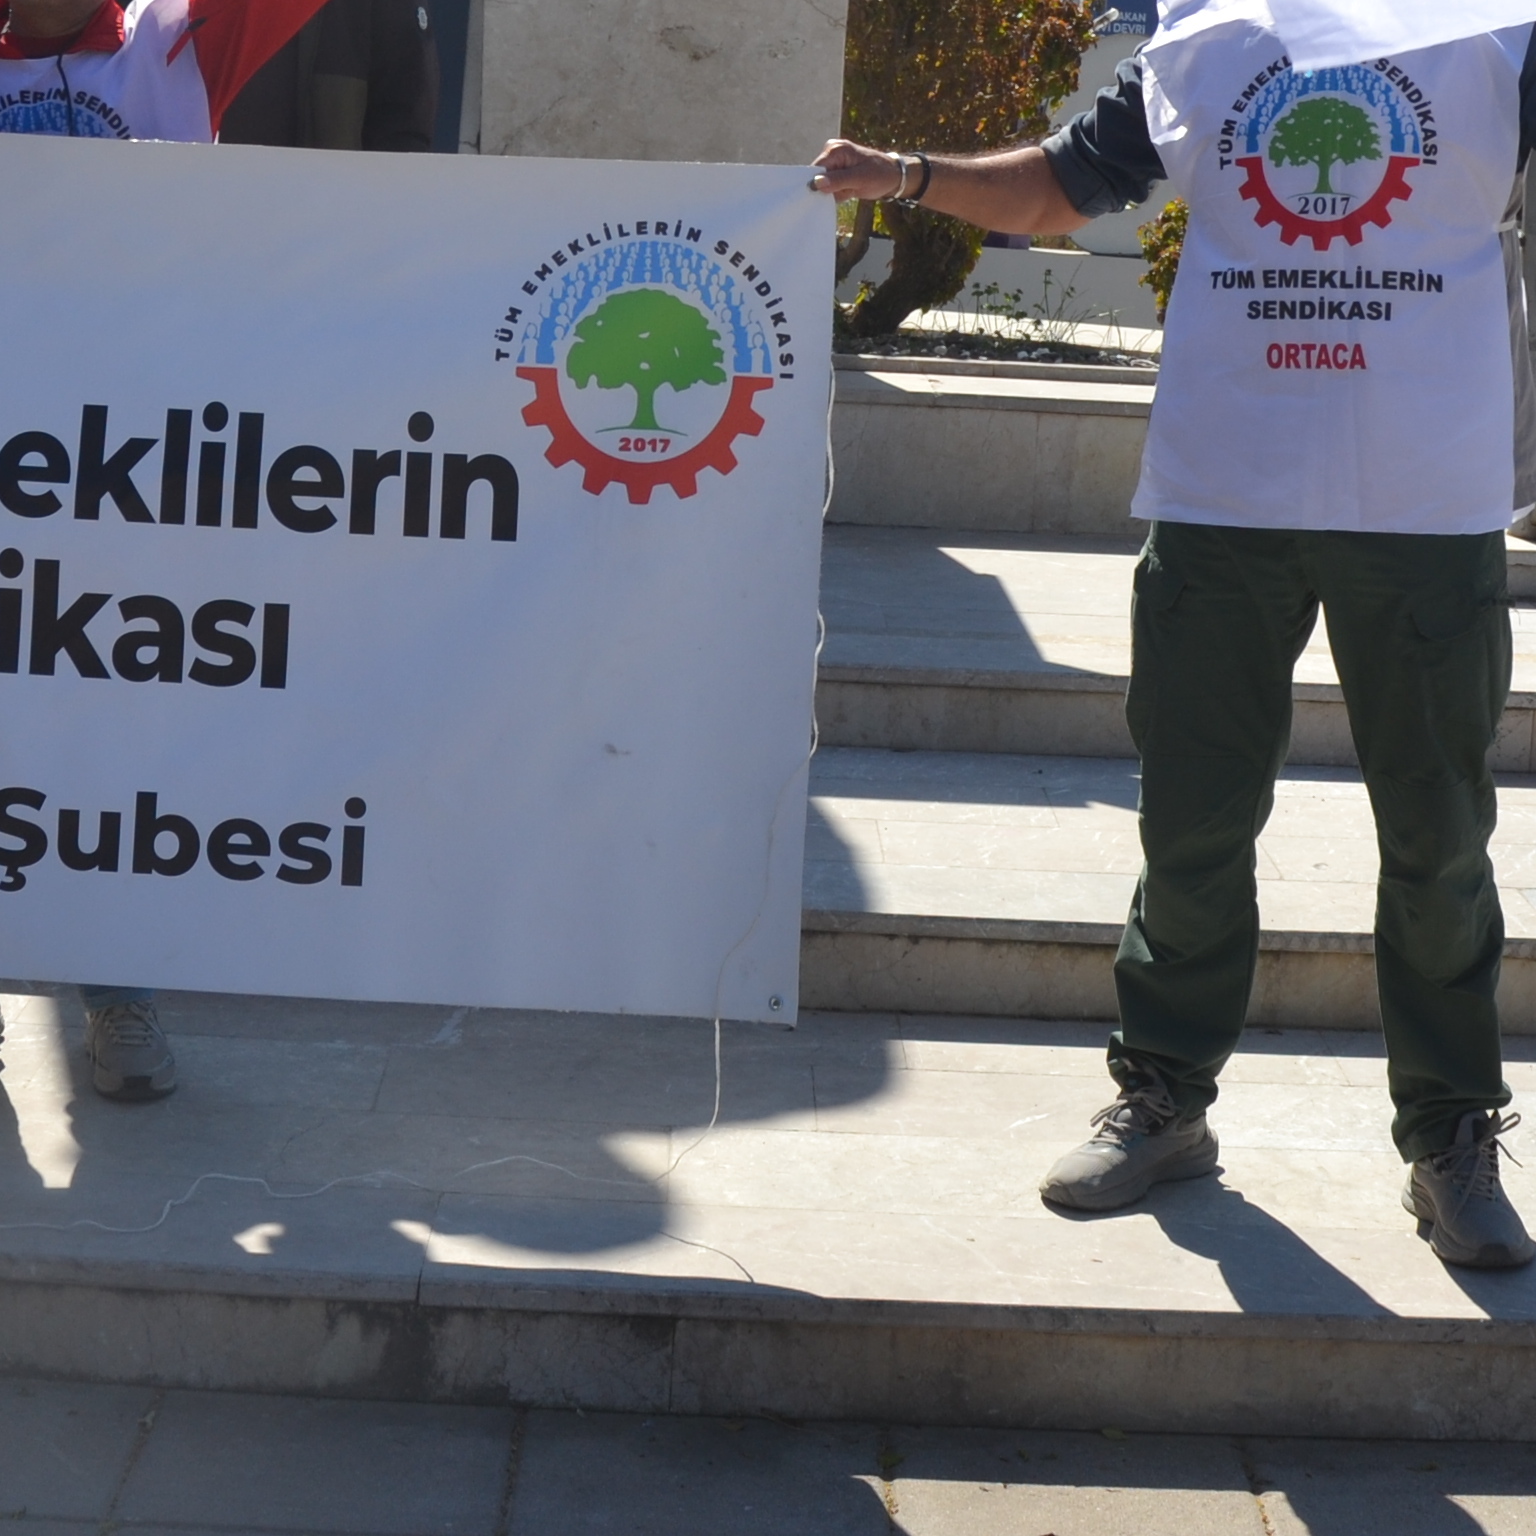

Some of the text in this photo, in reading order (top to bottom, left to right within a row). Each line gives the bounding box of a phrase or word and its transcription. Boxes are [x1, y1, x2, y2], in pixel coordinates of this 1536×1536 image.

[1217, 119, 1238, 170] TÜM
[1374, 58, 1438, 165] SENDİKASI
[1298, 196, 1351, 216] 2017
[1211, 265, 1444, 293] TÜM EMEKLİLERİN
[494, 220, 794, 379] TÜM EMEKLİLERİN SENDİKASI
[1246, 296, 1392, 322] SENDİKASI
[1266, 343, 1367, 370] ORTACA
[618, 437, 671, 453] 2017
